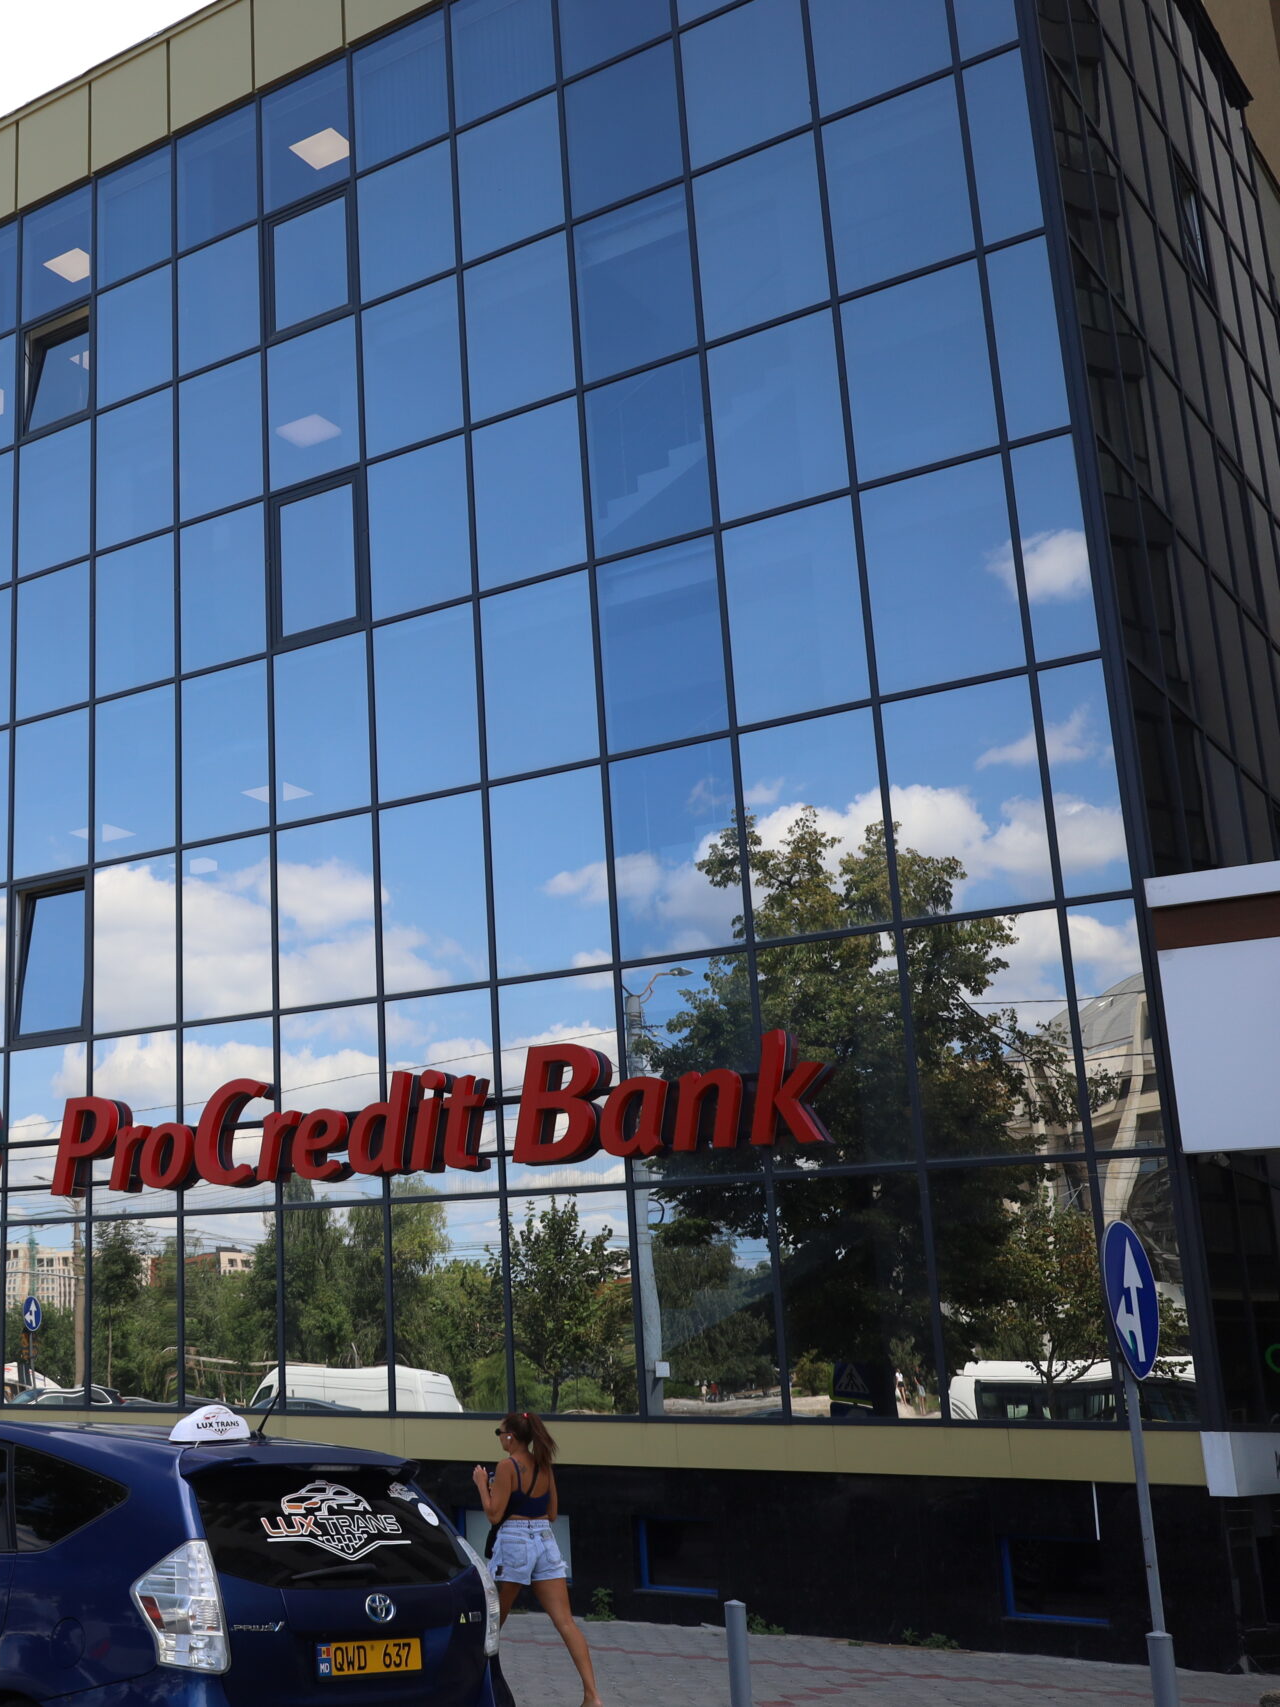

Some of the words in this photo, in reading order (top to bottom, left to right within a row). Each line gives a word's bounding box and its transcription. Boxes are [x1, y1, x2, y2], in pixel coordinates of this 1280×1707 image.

[51, 1068, 488, 1197] ProCredit
[512, 1029, 832, 1164] Bank
[196, 1421, 214, 1429] LUX
[215, 1420, 240, 1428] TRANS
[260, 1516, 321, 1536] LUX
[318, 1514, 402, 1534] TRANS
[333, 1645, 367, 1673] QWD
[382, 1642, 412, 1669] 637
